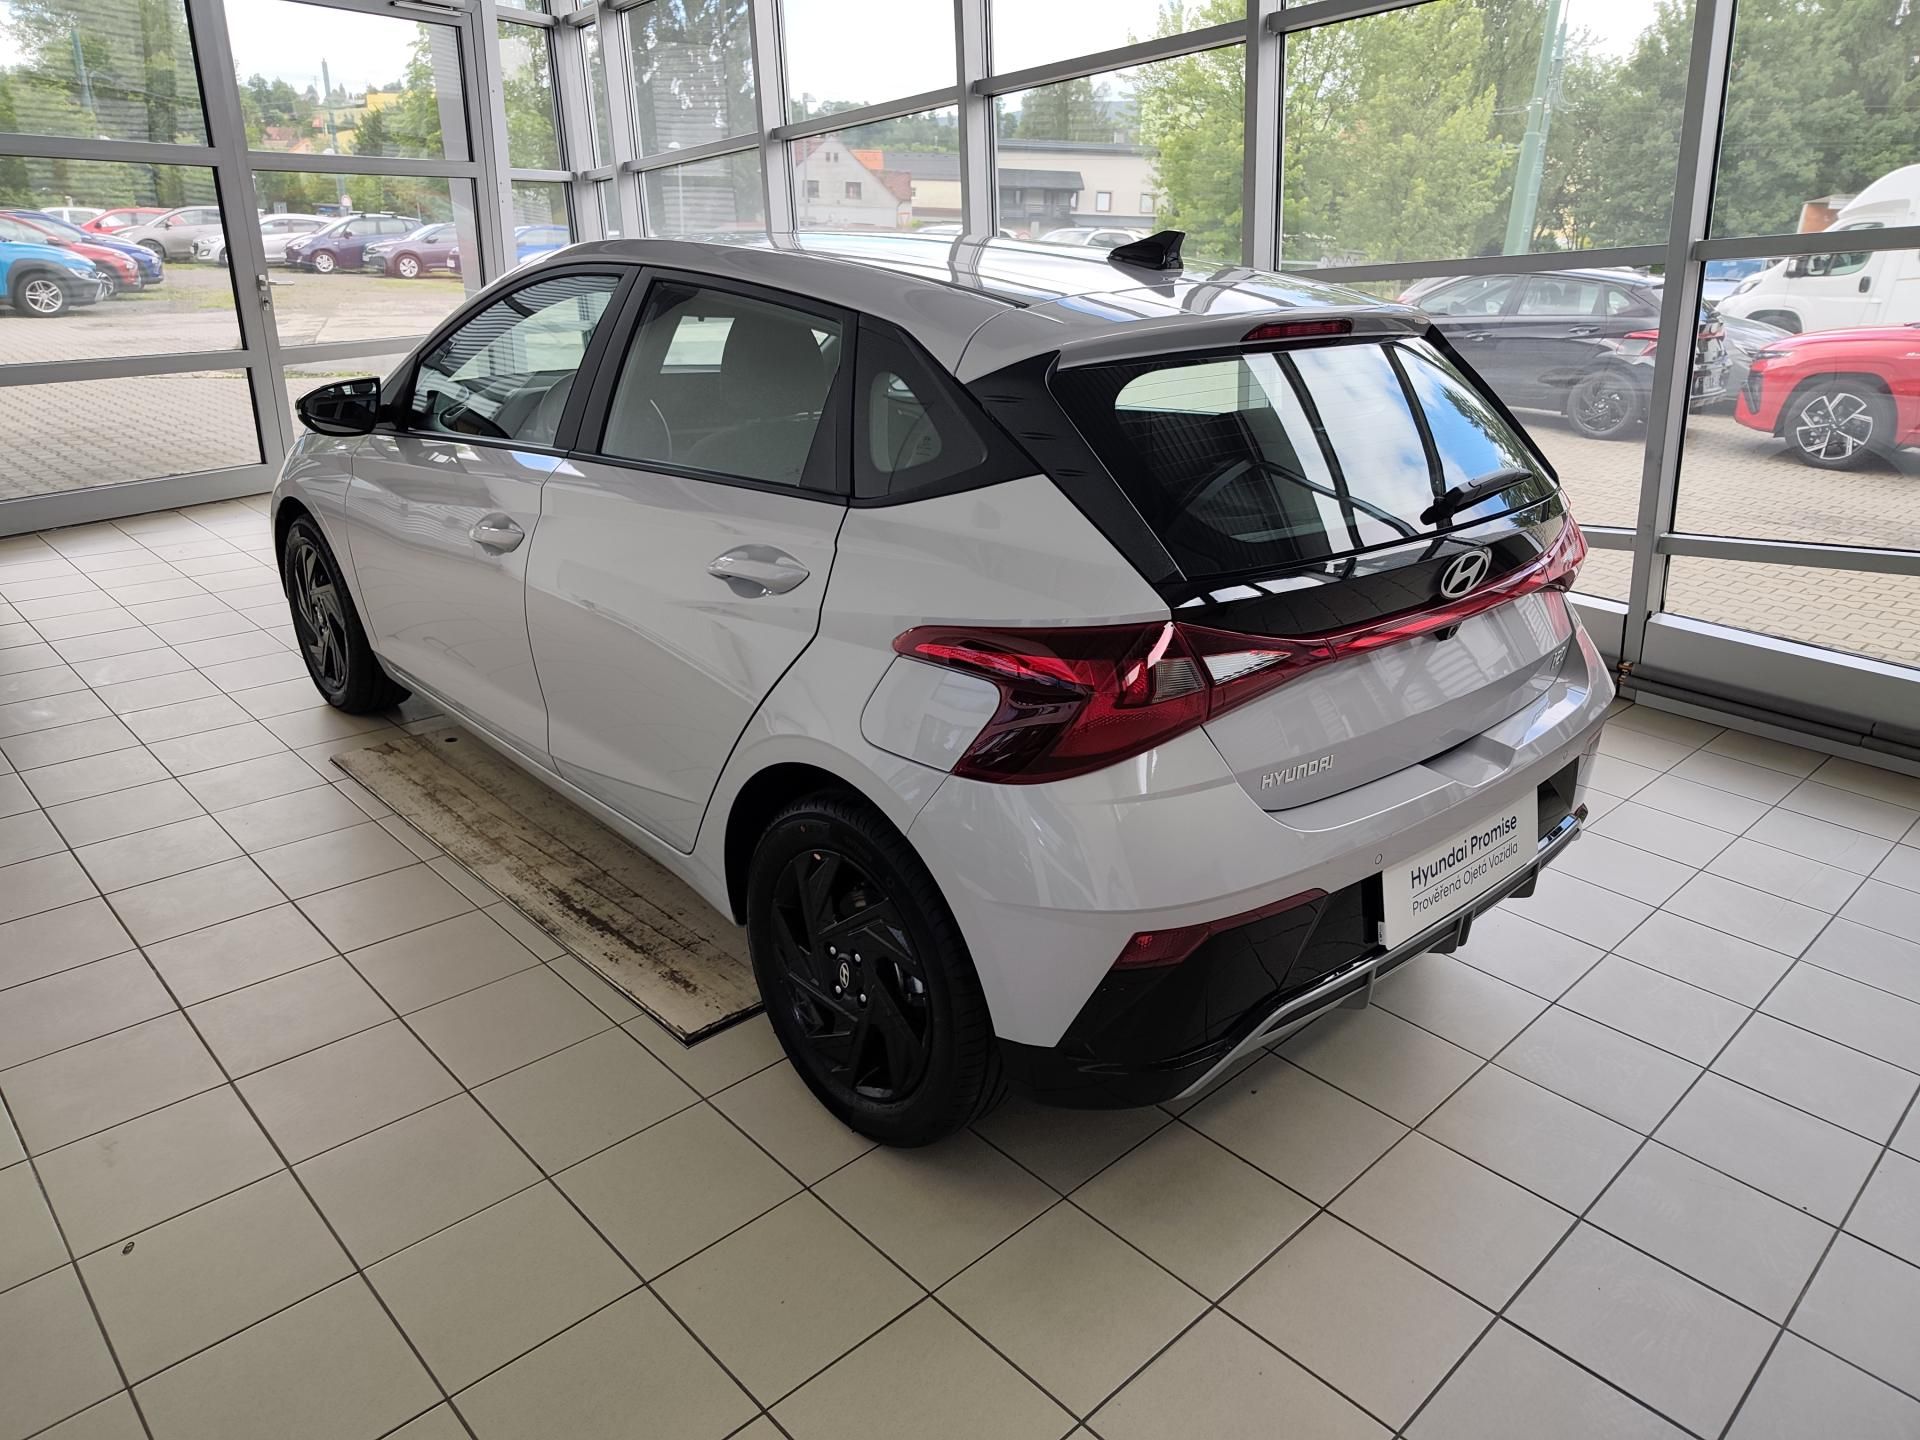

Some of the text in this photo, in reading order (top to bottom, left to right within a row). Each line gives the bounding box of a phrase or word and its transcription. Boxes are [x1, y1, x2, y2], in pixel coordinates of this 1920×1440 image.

[1261, 755, 1334, 790] HYUNDAI
[1411, 815, 1517, 889] Hyundai Promise
[1412, 842, 1518, 916] Prověřená Ojetá Vozidla
